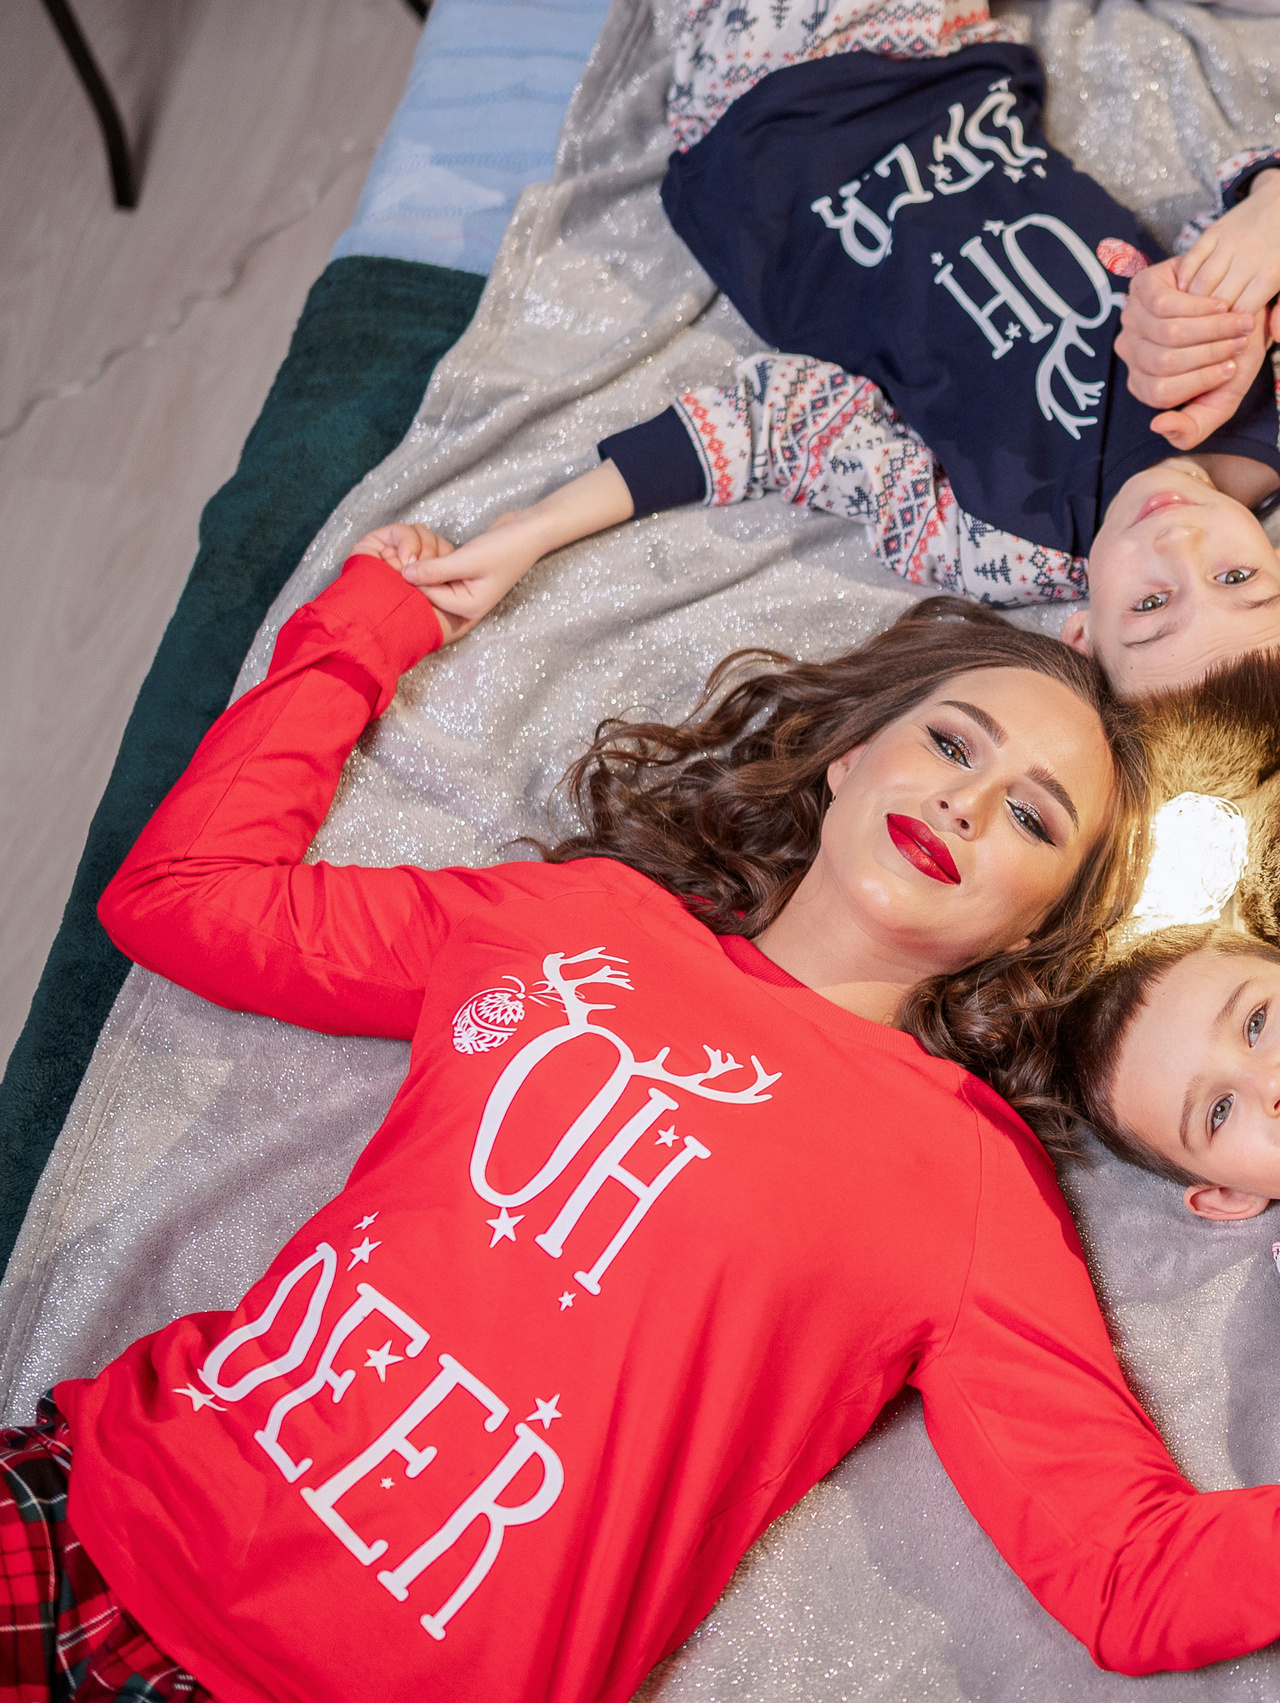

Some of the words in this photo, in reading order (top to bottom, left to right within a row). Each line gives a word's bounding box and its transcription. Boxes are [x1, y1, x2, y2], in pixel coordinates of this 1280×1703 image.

[934, 213, 1113, 360] OH
[469, 1024, 711, 1295] OH
[198, 1242, 565, 1640] DEER
